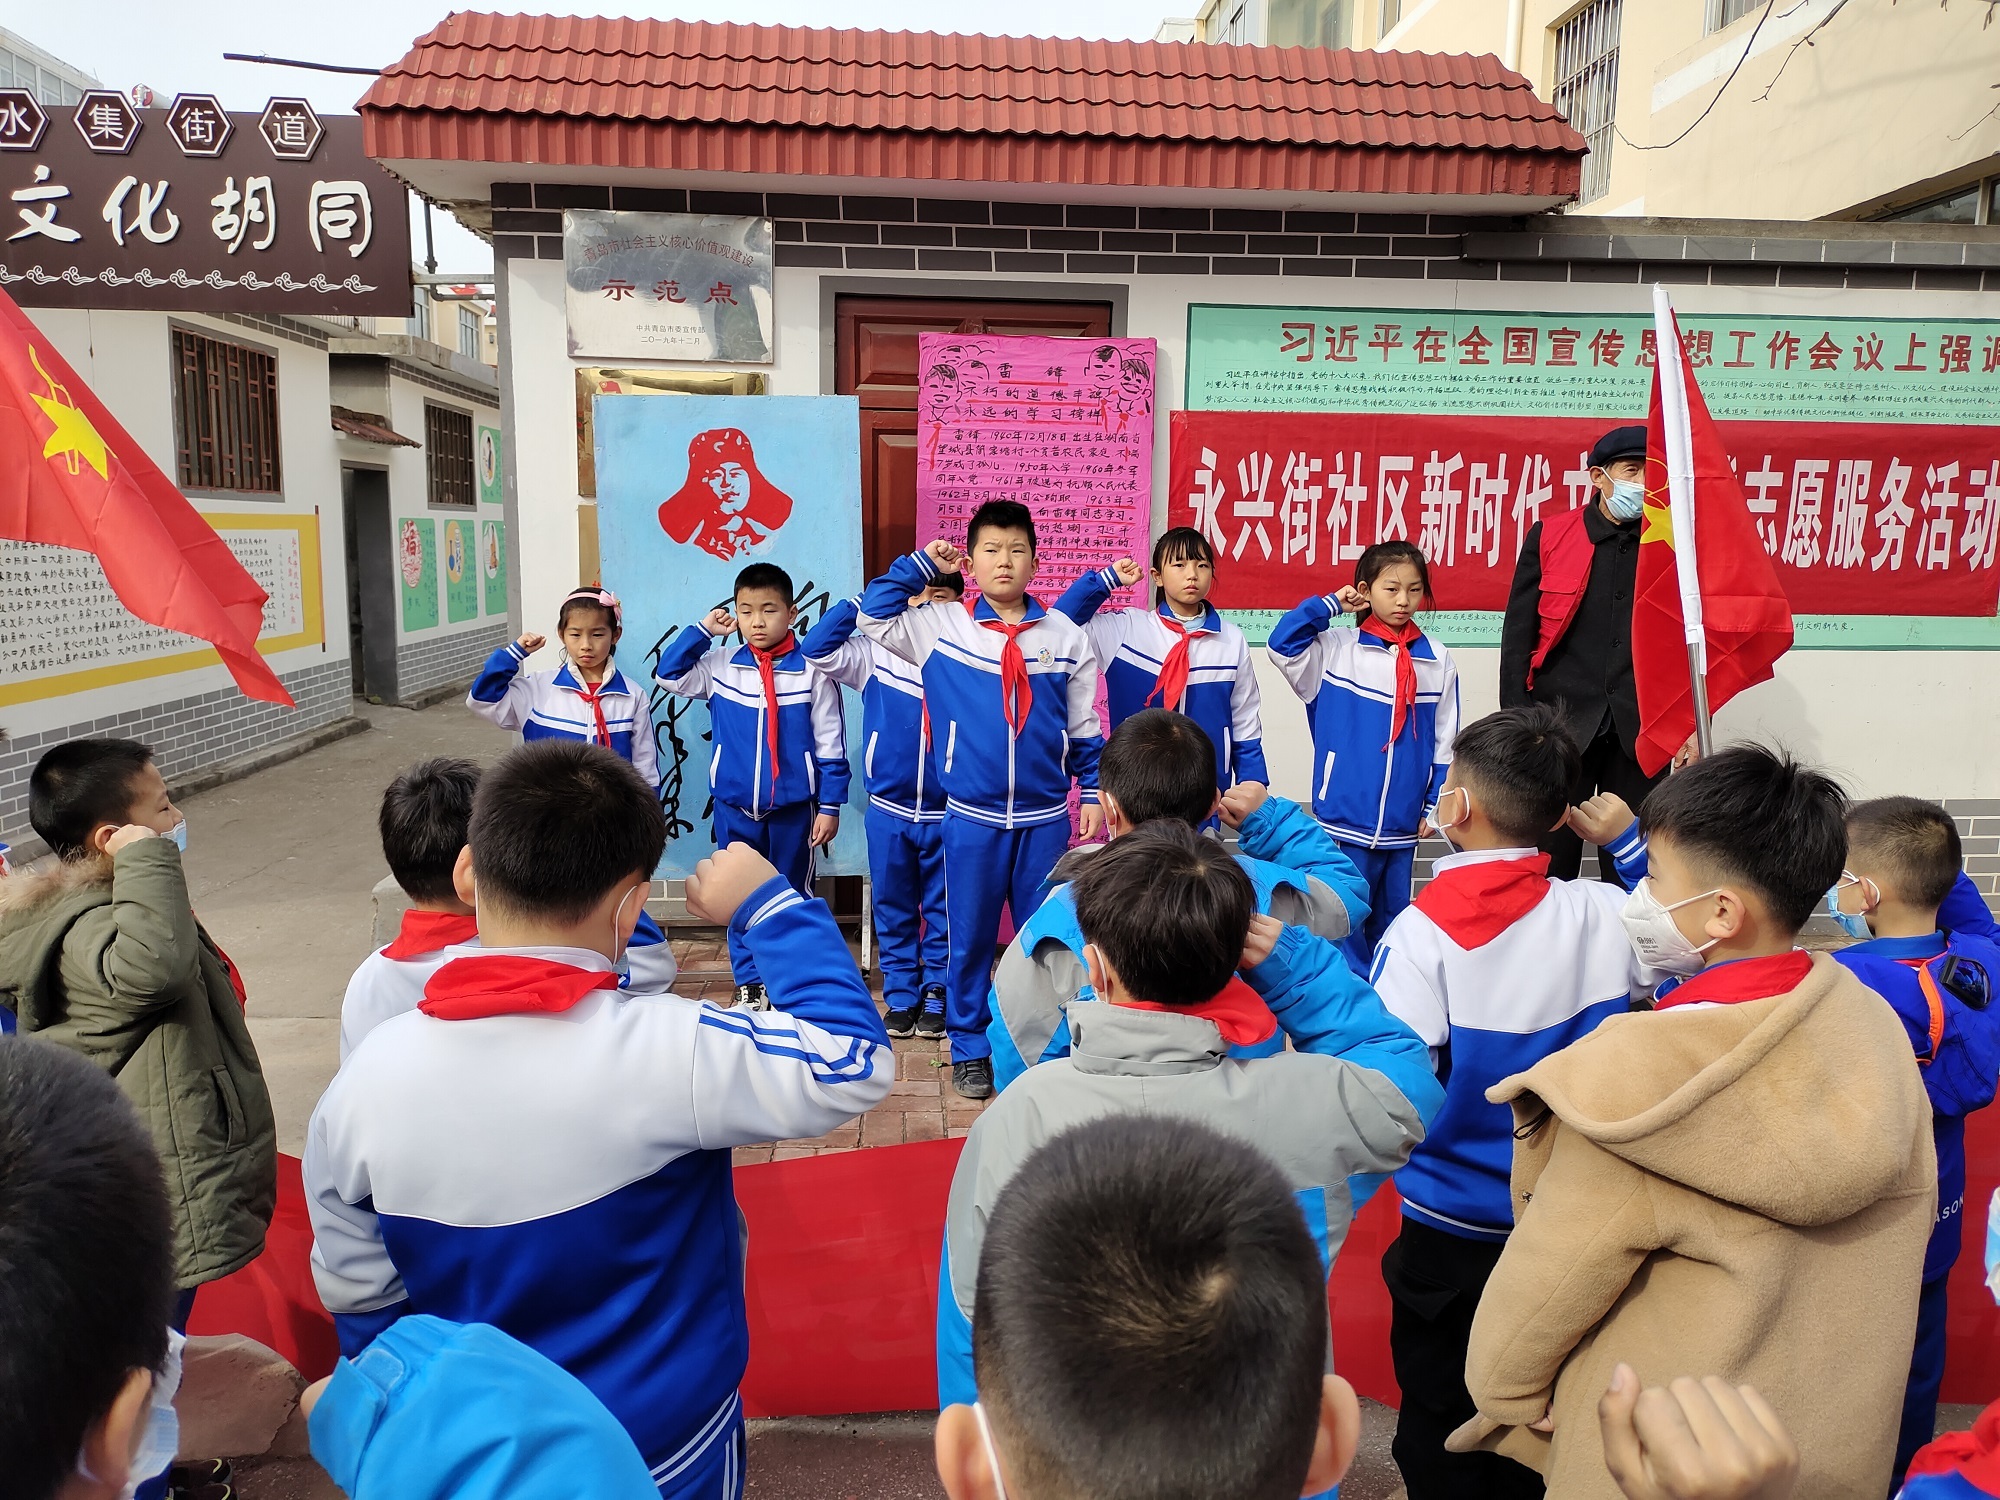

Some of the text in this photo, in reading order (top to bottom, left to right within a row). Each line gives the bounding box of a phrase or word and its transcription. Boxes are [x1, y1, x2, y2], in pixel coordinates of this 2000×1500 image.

[0, 102, 308, 146] 水集街道
[6, 164, 374, 258] 文化胡同
[583, 234, 754, 268] 青岛市社会主义核心价值观建设
[601, 279, 738, 306] 示范点
[636, 324, 706, 334] 中共青岛市委宣传部
[997, 363, 1066, 384] 雷锋
[963, 404, 1102, 425] 永远的学习榜样
